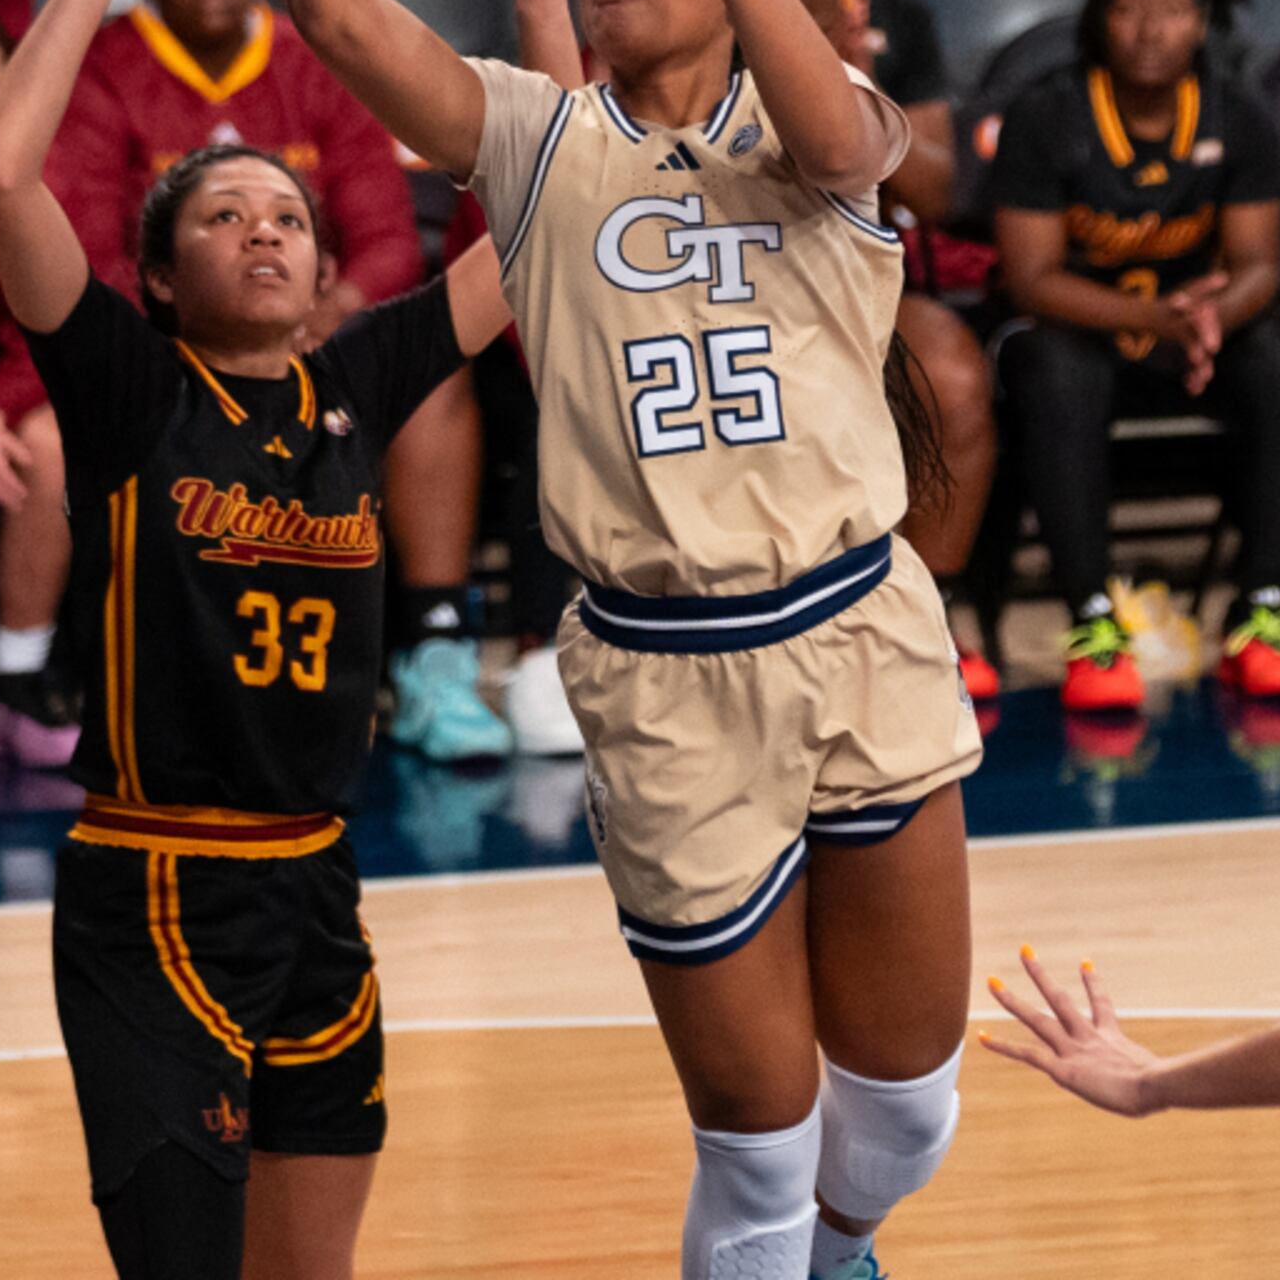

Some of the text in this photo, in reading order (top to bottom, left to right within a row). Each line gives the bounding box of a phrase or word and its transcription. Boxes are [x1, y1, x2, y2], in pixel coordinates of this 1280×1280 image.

[594, 187, 783, 305] GT
[623, 324, 787, 459] 25
[170, 476, 382, 568] Warhawk
[232, 589, 336, 692] 33
